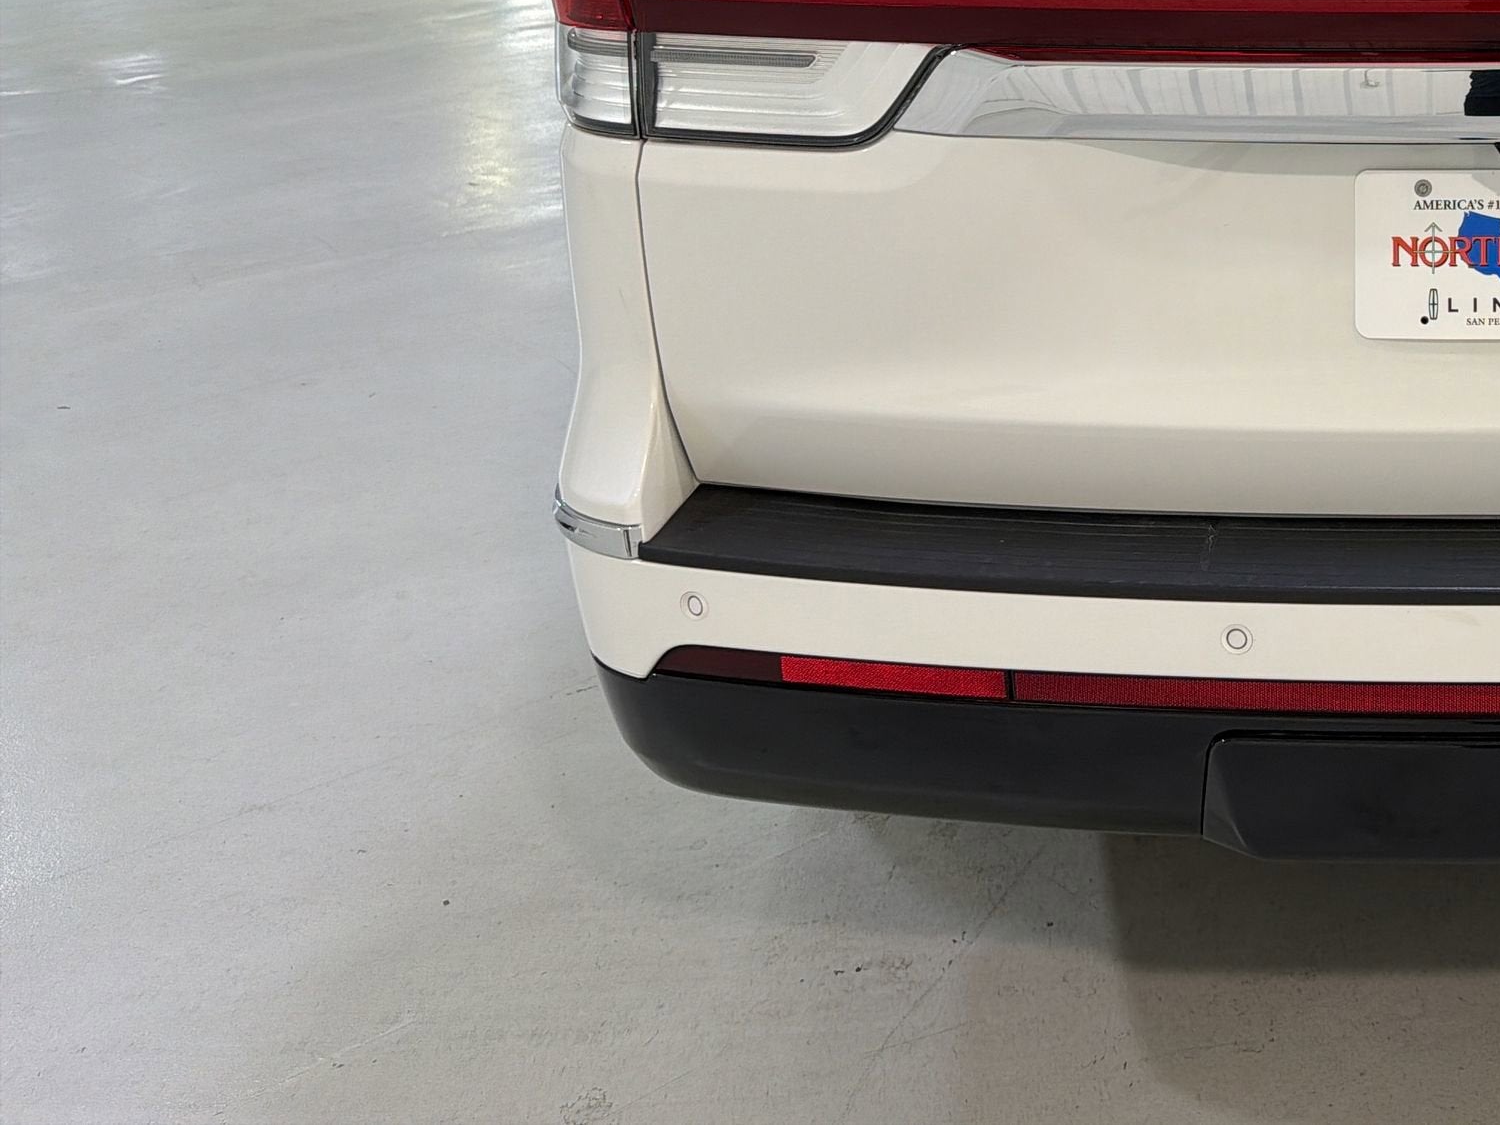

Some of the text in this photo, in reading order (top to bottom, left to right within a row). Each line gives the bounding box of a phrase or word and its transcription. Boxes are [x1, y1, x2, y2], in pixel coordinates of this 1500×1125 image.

[1413, 199, 1485, 210] AMERICA'S
[1487, 199, 1500, 210] #1
[1466, 317, 1487, 326] SAN
